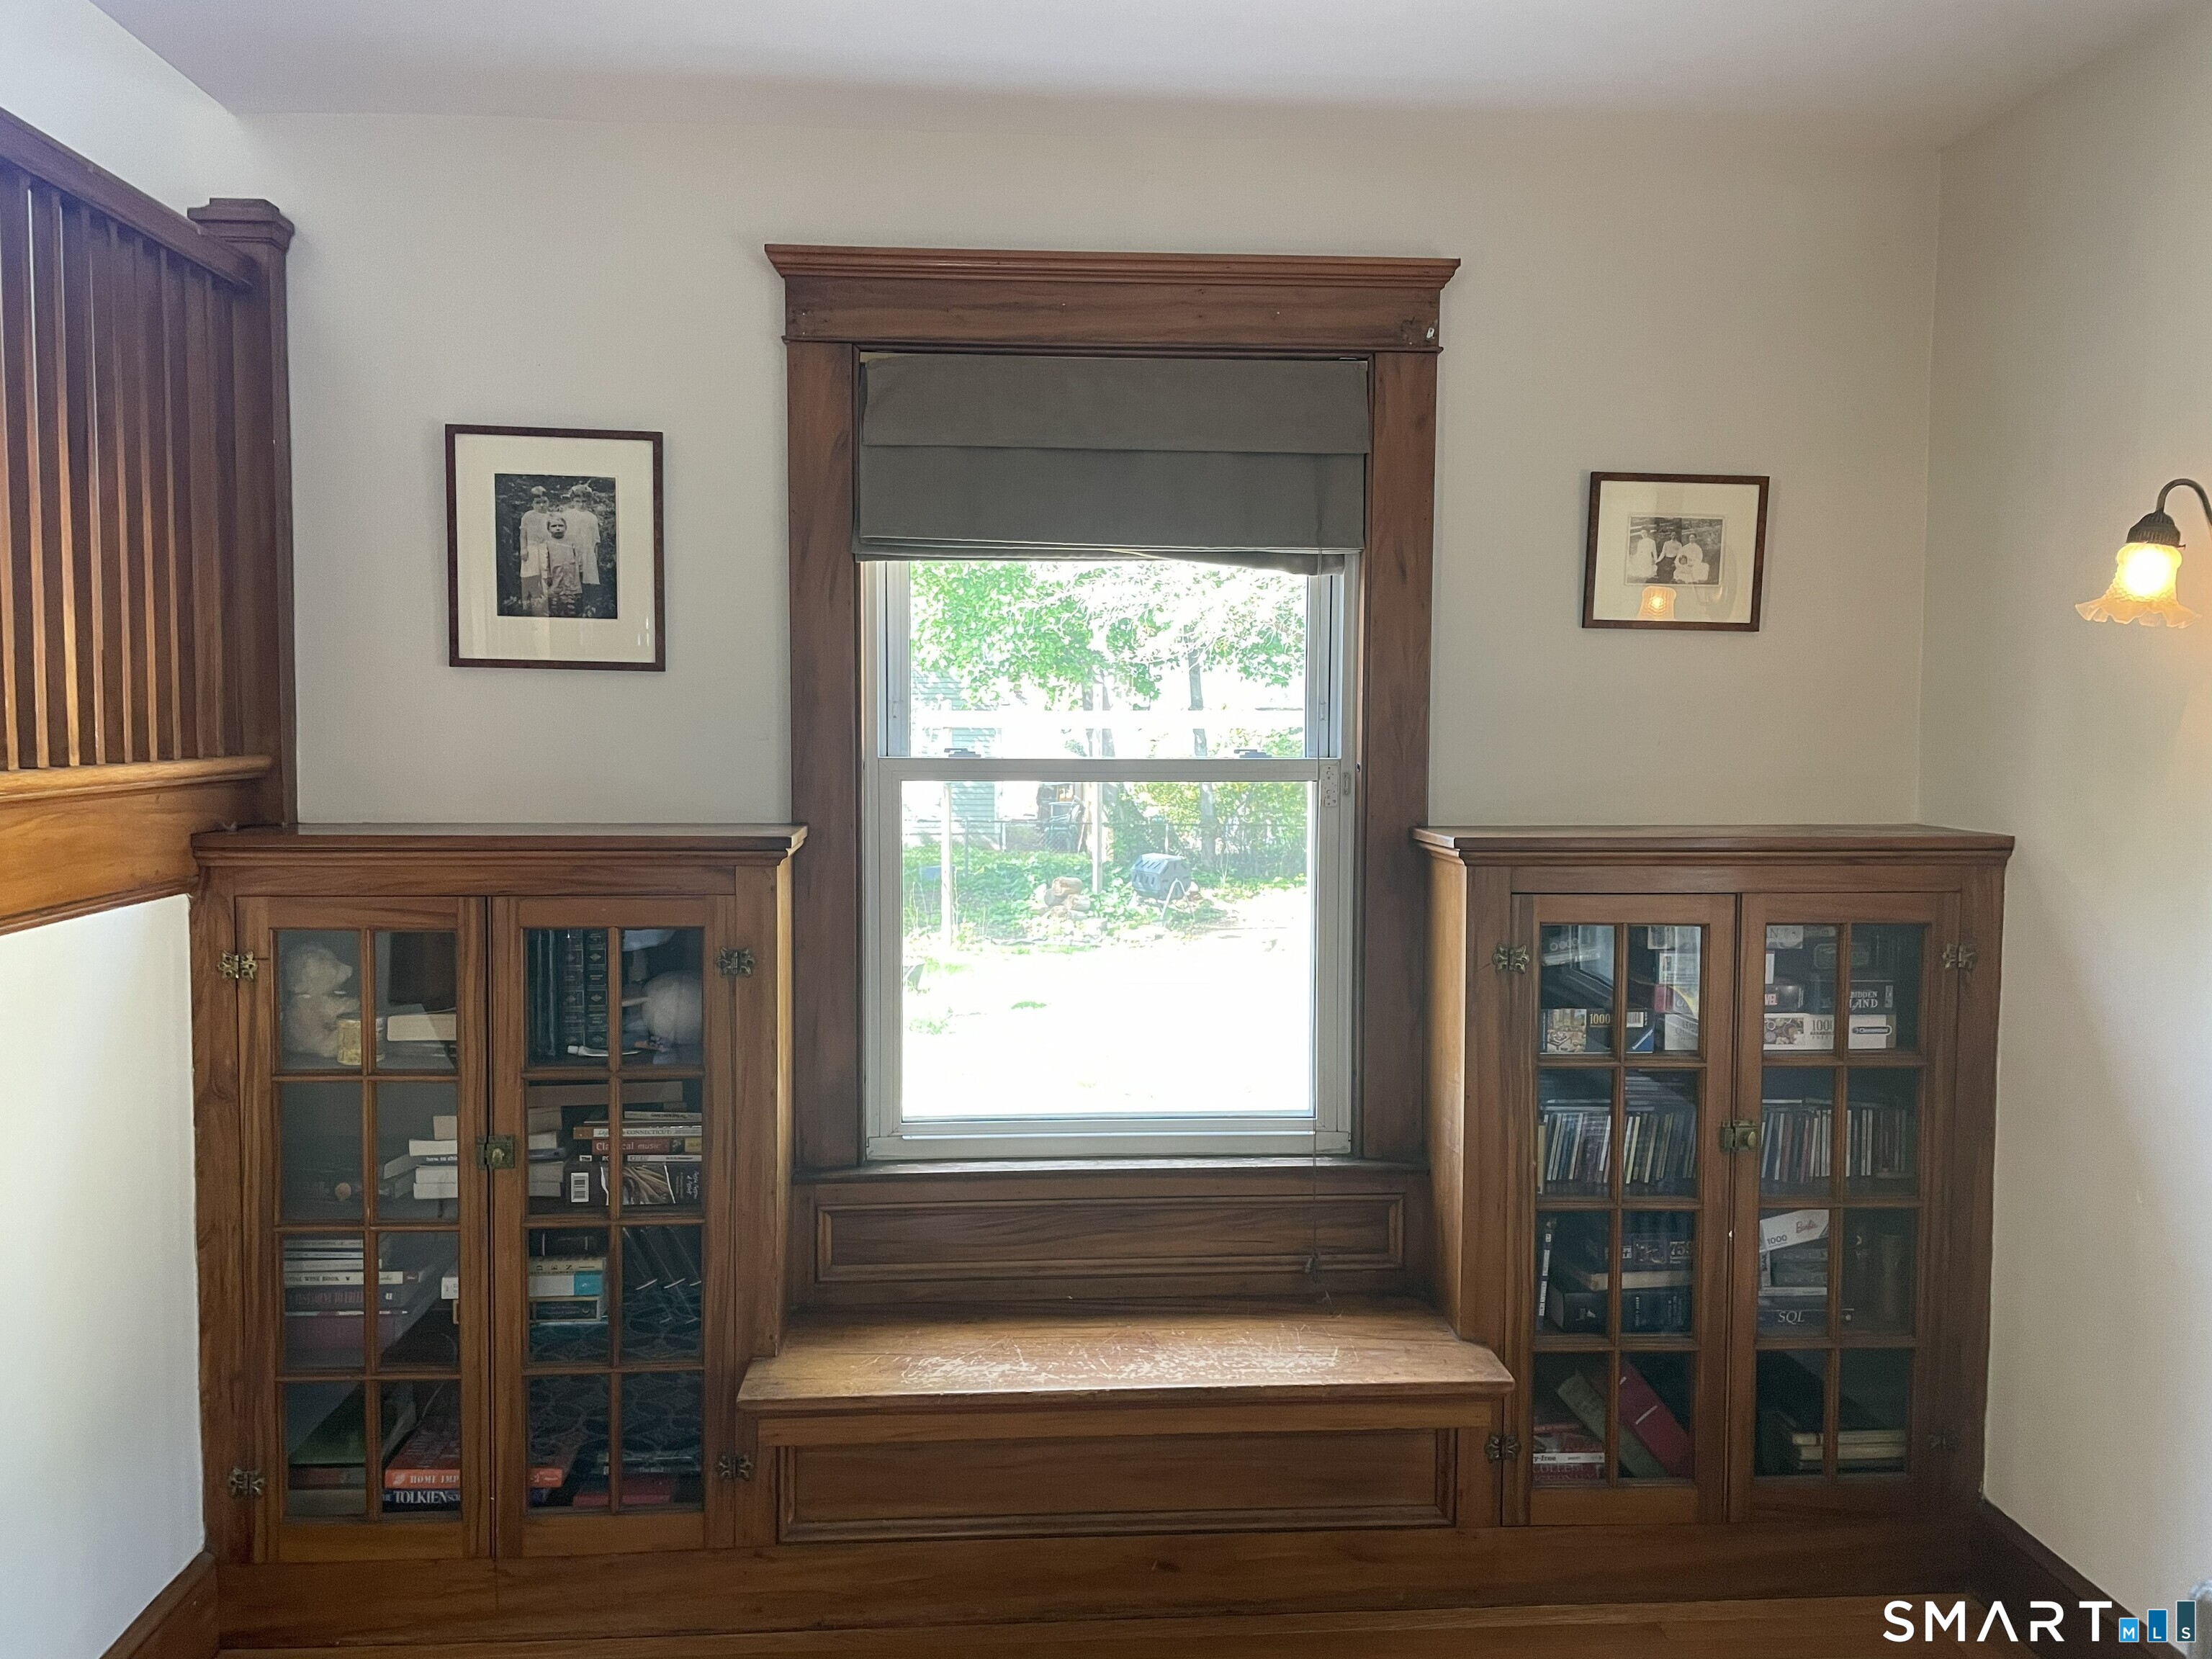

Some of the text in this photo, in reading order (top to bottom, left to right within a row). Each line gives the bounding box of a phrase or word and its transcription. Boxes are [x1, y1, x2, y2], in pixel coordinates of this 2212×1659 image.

[1590, 1013, 1611, 1024] 1000
[1767, 1235, 1787, 1245] 1000
[1778, 1310, 1805, 1325] SQL
[393, 1491, 448, 1503] TOLKIEN
